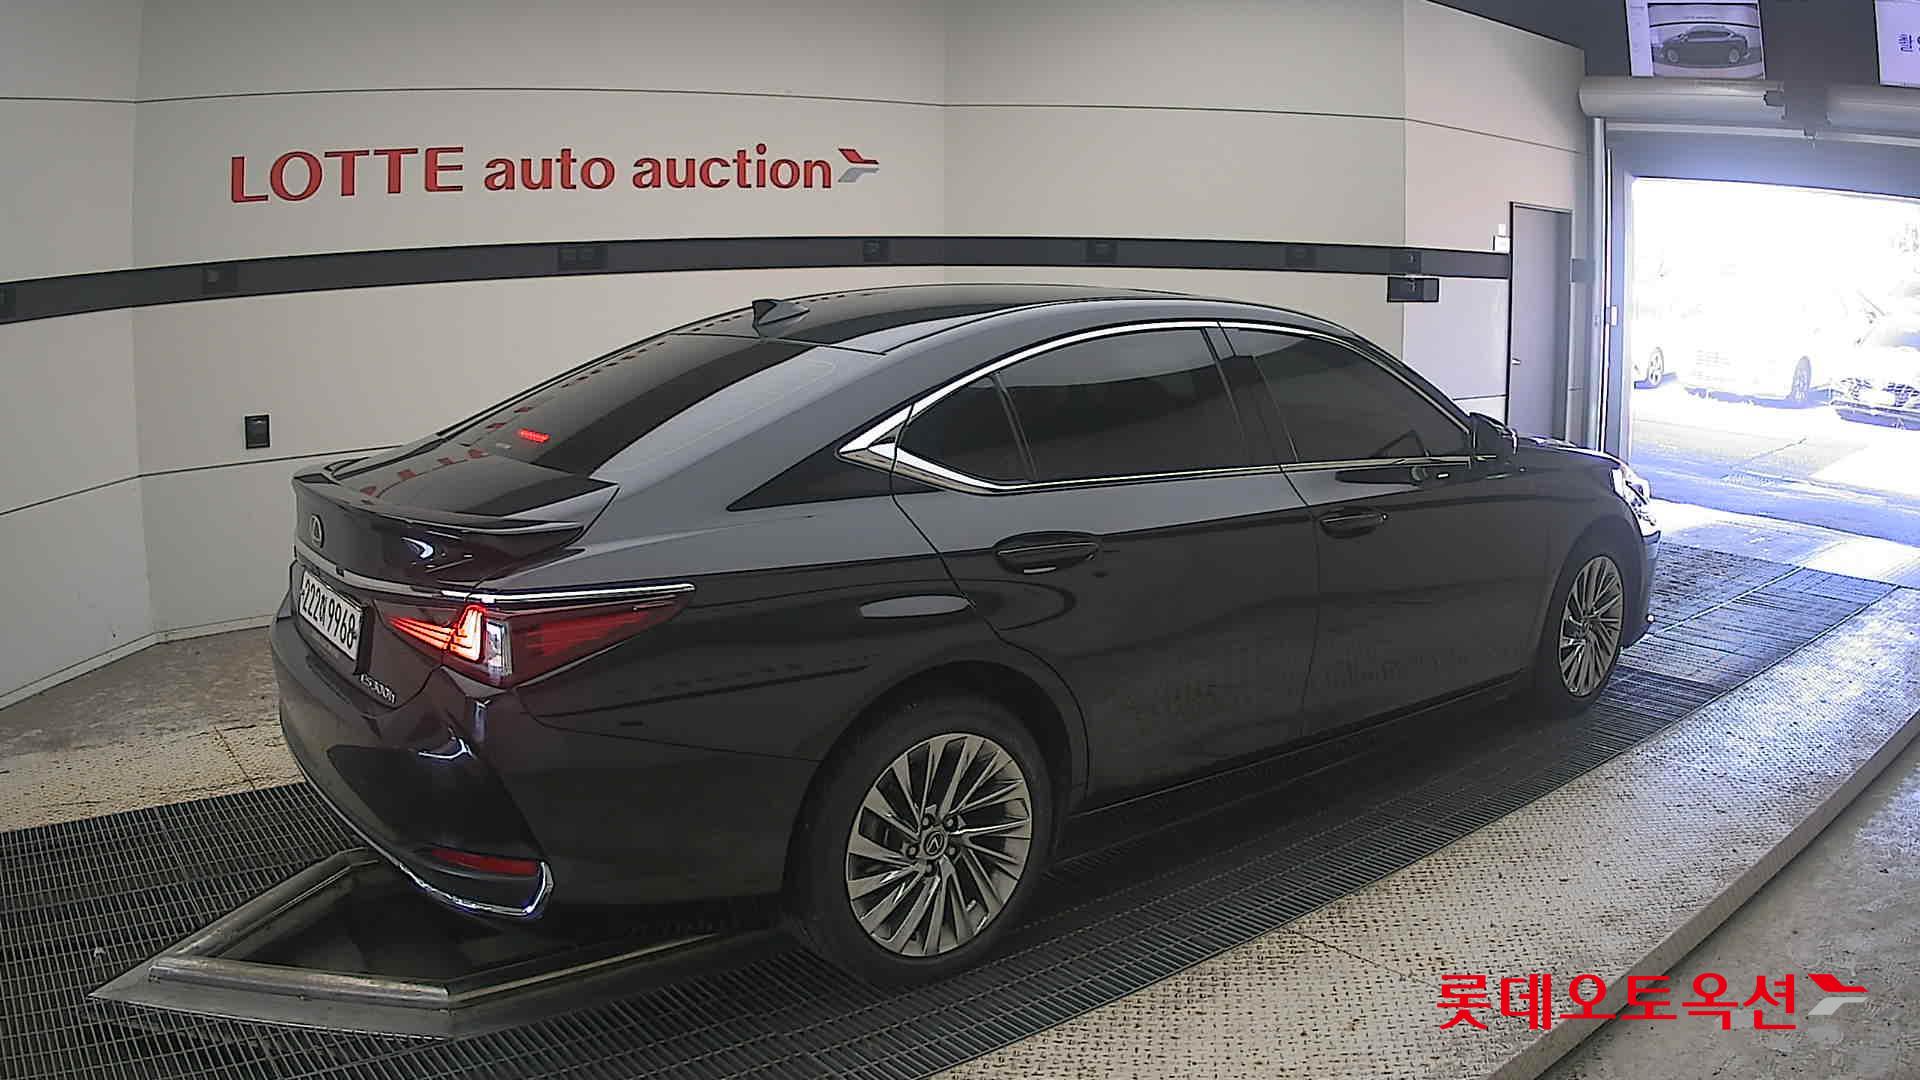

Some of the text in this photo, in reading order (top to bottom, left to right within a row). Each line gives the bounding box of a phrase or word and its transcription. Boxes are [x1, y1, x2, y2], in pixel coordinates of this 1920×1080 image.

[231, 143, 832, 203] LOTTE auto auction
